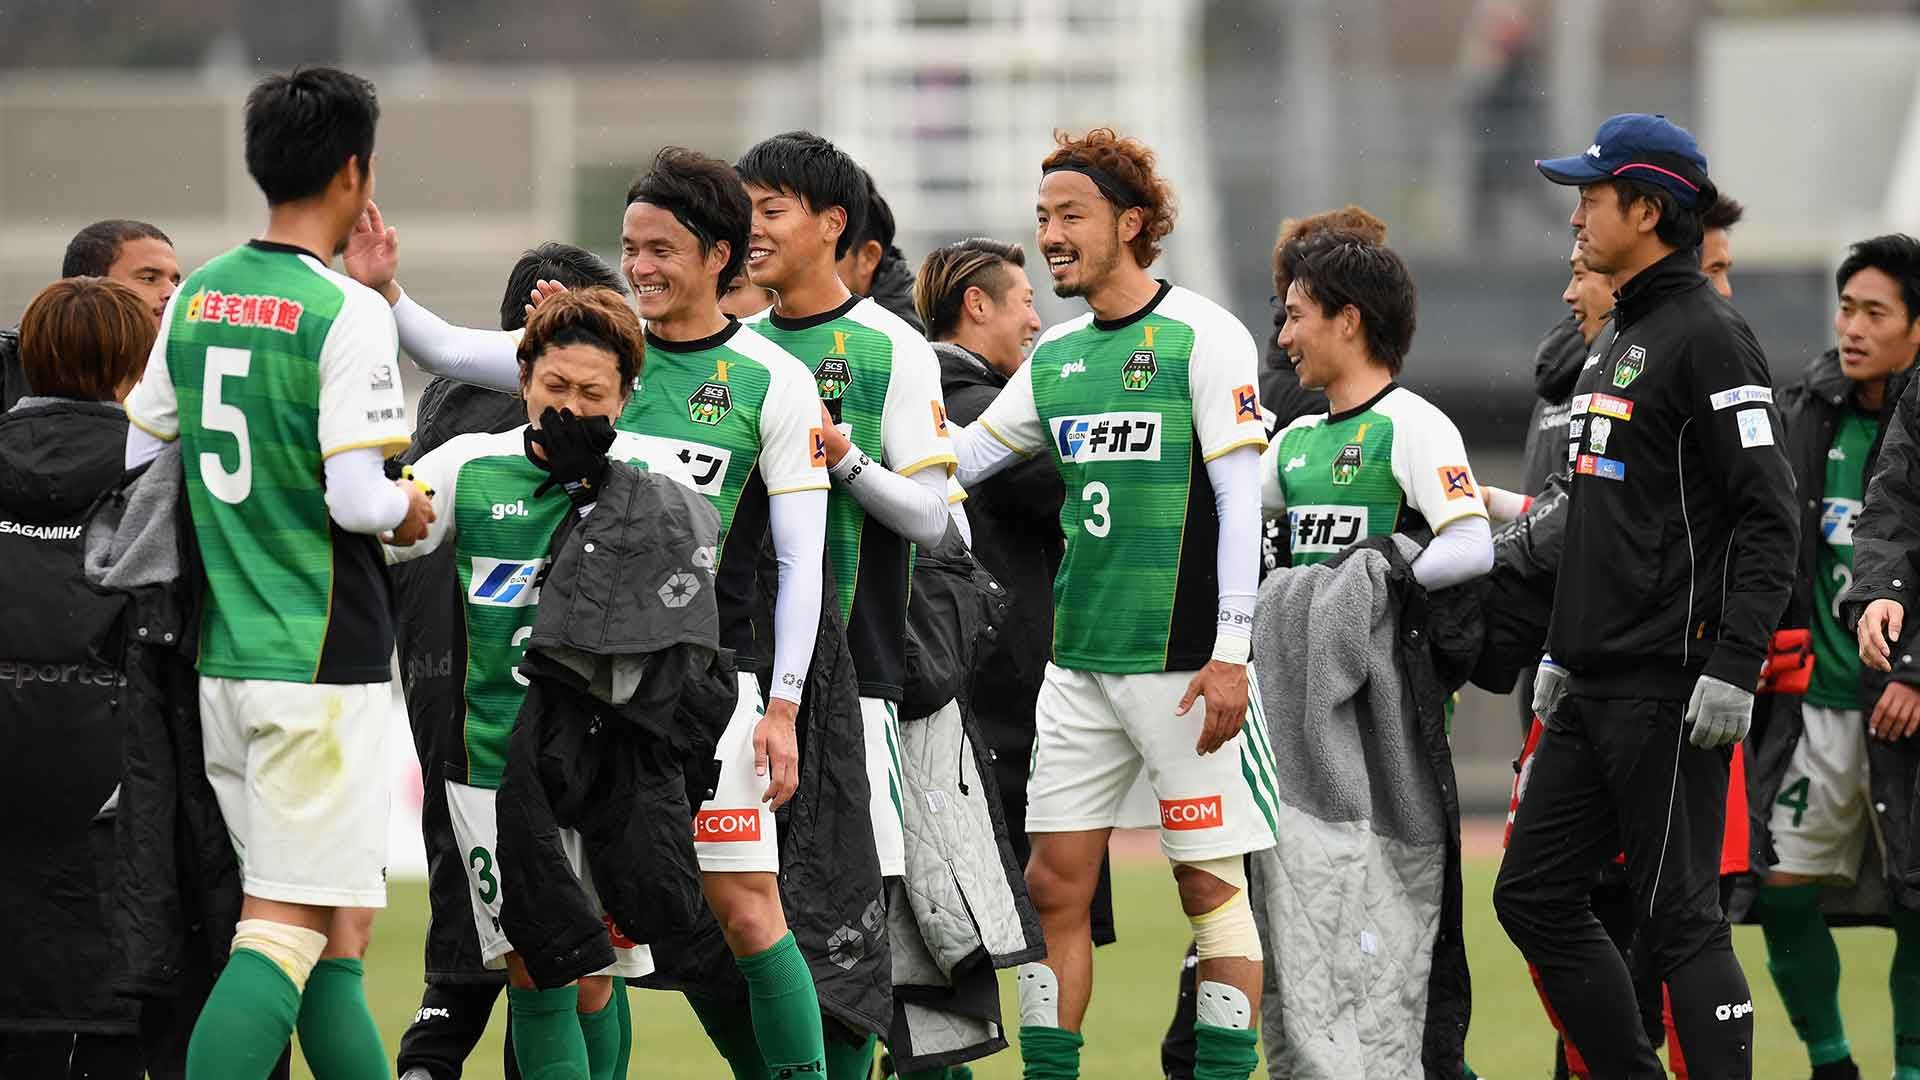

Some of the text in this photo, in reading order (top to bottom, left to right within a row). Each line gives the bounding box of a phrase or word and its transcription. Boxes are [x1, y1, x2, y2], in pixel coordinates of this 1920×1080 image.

[201, 290, 303, 335] 住宅情報館
[824, 362, 843, 370] SCS
[1060, 358, 1086, 378] gol.
[1133, 354, 1150, 362] SCS
[704, 387, 724, 397] SCS
[200, 346, 252, 504] 5
[1089, 420, 1155, 453] ギオン
[491, 500, 529, 520] gol.
[1082, 481, 1111, 538] 3
[1298, 513, 1362, 545] ギオン
[1233, 614, 1252, 625] go
[1776, 776, 1811, 828] 4
[694, 814, 757, 837] J:COM
[469, 846, 498, 905] 3
